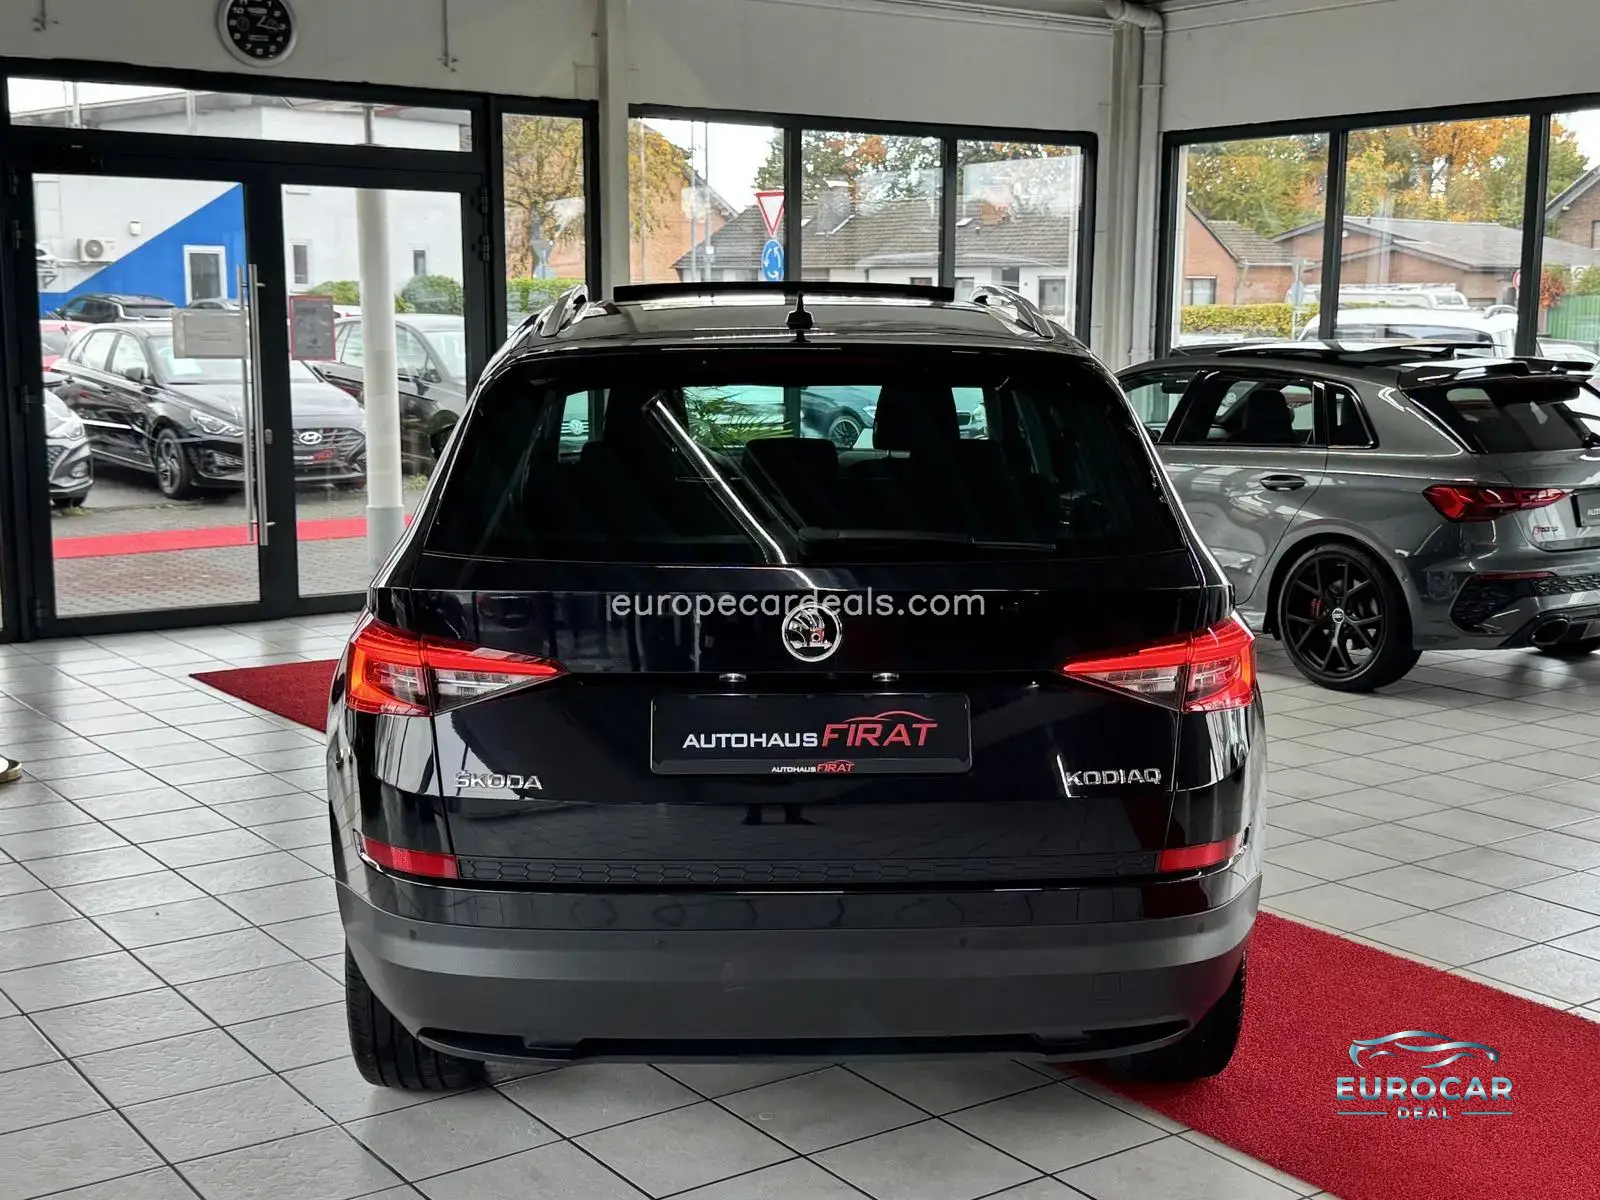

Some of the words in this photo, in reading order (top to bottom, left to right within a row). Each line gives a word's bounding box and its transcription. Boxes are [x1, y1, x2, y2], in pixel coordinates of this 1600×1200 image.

[682, 732, 818, 749] AUTOHAUS
[822, 723, 938, 748] FIRAT
[817, 763, 855, 772] FIRAT
[1065, 768, 1162, 786] KODIAQ
[454, 769, 543, 790] ŠKODA
